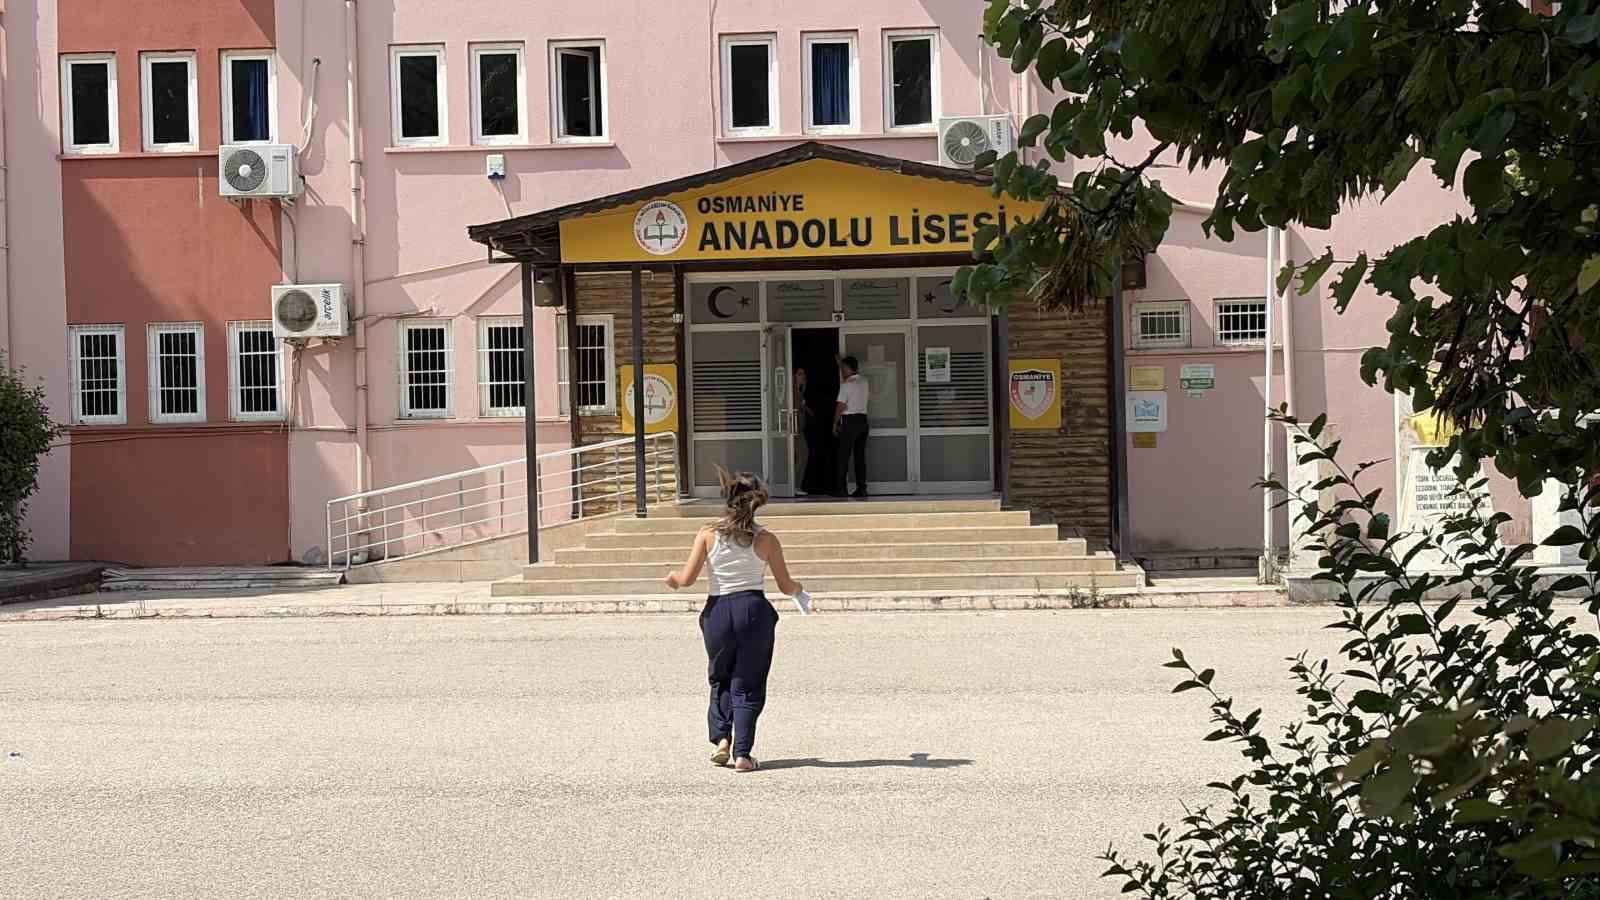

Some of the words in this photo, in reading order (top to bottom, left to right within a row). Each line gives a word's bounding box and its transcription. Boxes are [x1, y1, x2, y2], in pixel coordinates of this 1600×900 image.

[697, 191, 804, 214] OSMANİYE
[698, 216, 872, 251] ANADOLU
[889, 204, 1007, 246] LİSESİ
